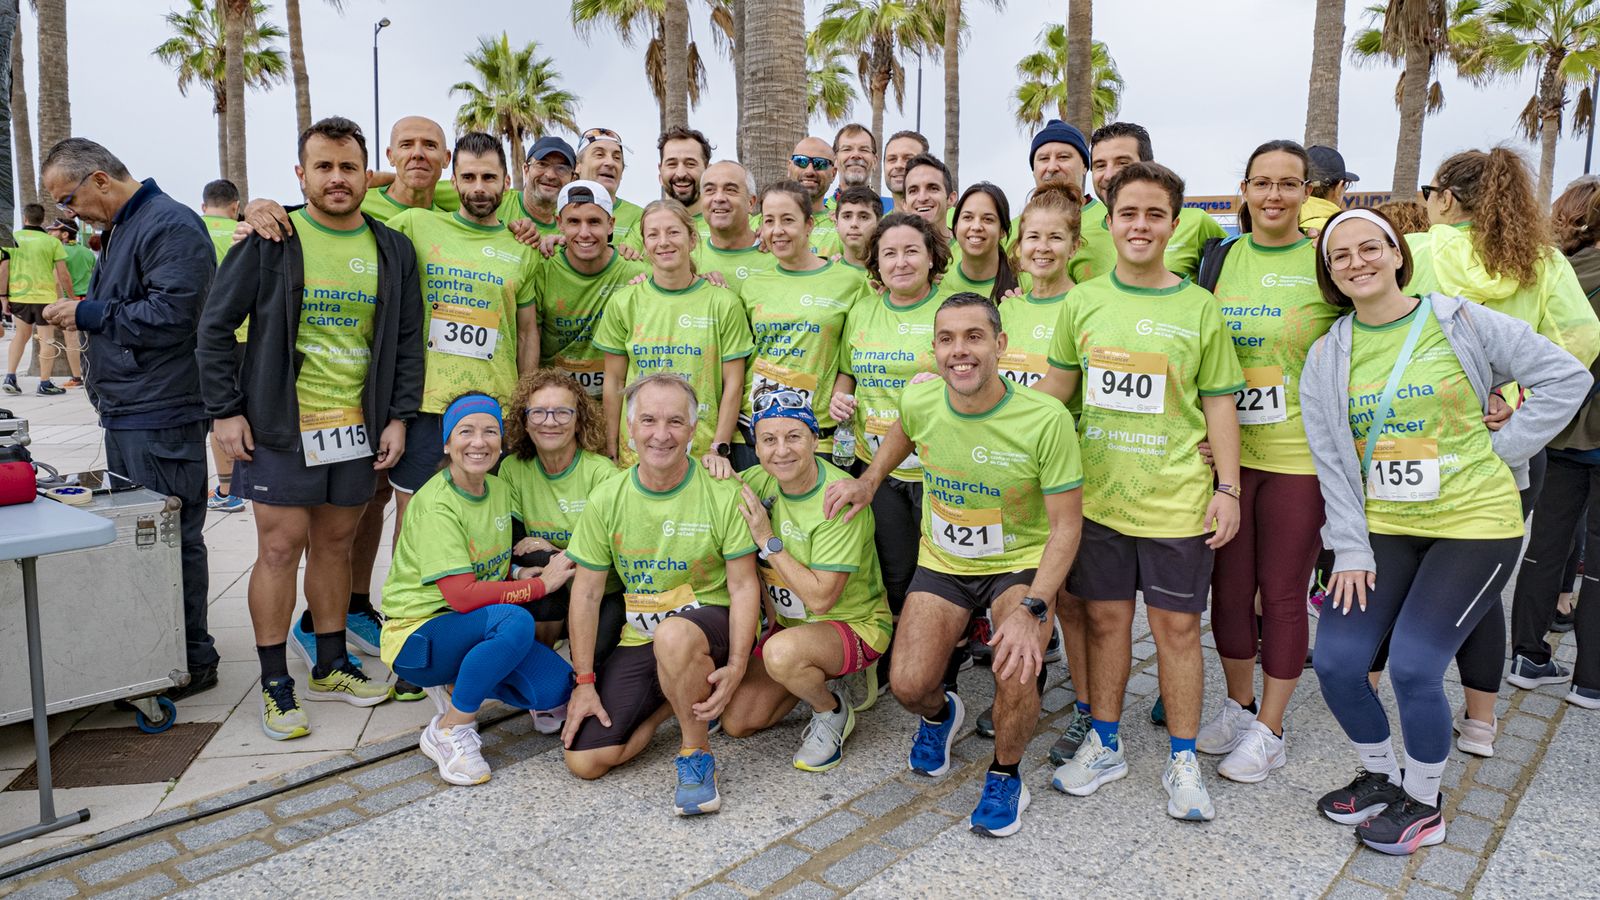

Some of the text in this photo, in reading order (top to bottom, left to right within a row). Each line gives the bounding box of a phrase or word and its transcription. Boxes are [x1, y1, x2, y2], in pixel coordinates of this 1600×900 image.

[427, 264, 504, 286] En marcha
[427, 279, 473, 293] contra
[314, 288, 378, 305] marcha
[427, 291, 491, 309] el cáncer
[1221, 304, 1281, 317] marcha
[306, 314, 360, 327] cáncer
[769, 320, 820, 333] marcha
[444, 321, 488, 347] 360
[1231, 335, 1266, 347] ncer
[633, 343, 702, 356] En marcha
[864, 350, 915, 362] marcha
[860, 375, 906, 388] cáncer
[1101, 370, 1153, 399] 940
[1359, 383, 1434, 407] macha
[1350, 407, 1396, 425] onta
[312, 424, 366, 451] 1115
[1108, 430, 1168, 446] HYUNDAI
[1375, 460, 1424, 486] 155
[936, 475, 1001, 497] marcha
[928, 487, 965, 505] ntra
[529, 529, 573, 541] march
[943, 523, 989, 547] 421
